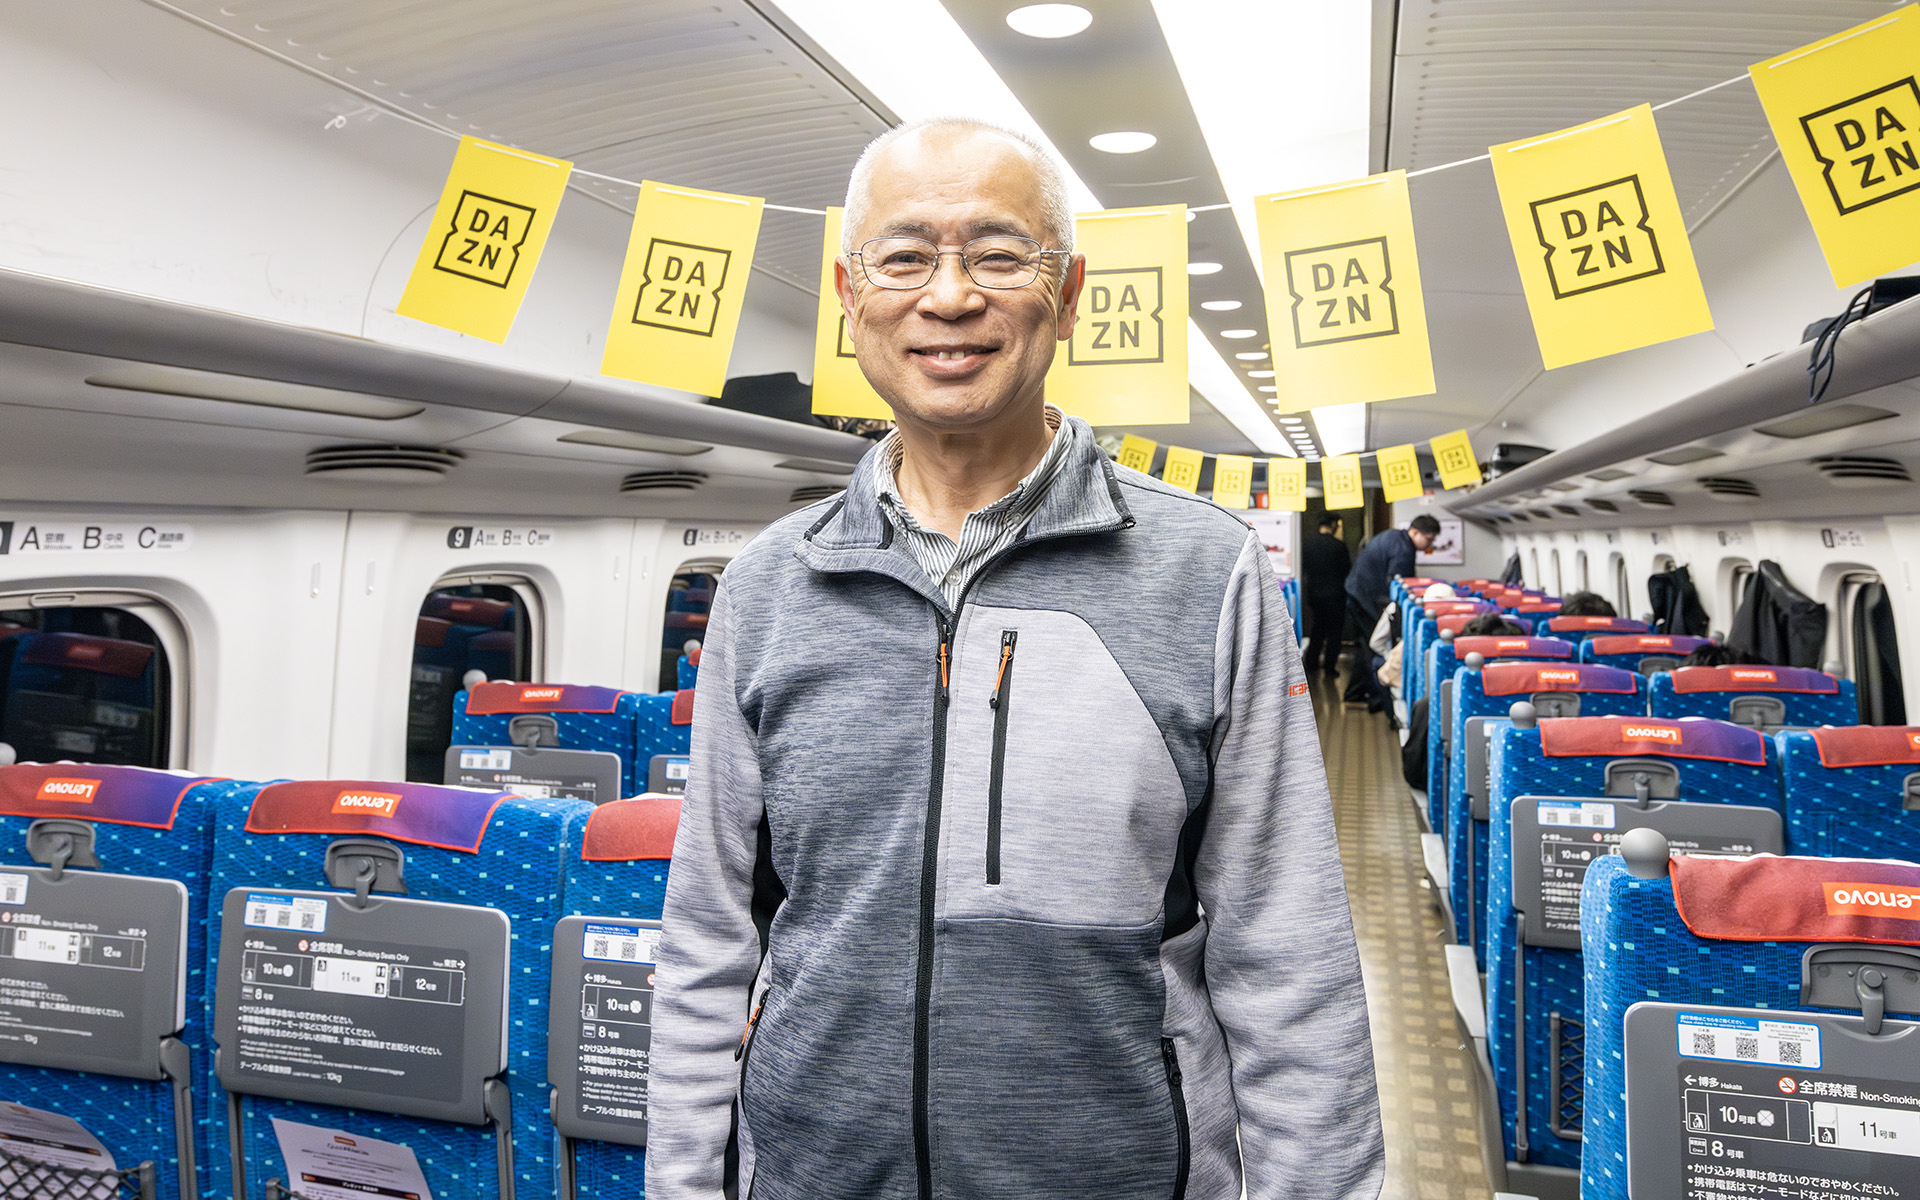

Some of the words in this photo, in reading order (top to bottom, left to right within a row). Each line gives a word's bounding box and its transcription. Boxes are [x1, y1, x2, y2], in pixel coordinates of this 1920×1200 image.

[1834, 106, 1907, 152] DA
[1850, 140, 1920, 189] ZN
[469, 208, 510, 240] DA
[1560, 201, 1625, 240] DA
[457, 238, 502, 270] ZN
[1570, 235, 1633, 277] ZN
[663, 256, 706, 287] DA
[1312, 258, 1369, 292] DA
[655, 288, 701, 319] ZN
[1091, 285, 1141, 314] DA
[1316, 293, 1371, 328] ZN
[1091, 320, 1140, 349] ZN
[20, 526, 40, 550] A
[83, 526, 102, 549] B
[138, 526, 156, 549] C
[454, 529, 465, 547] 9
[474, 529, 484, 546] A
[502, 529, 512, 546] B
[527, 529, 538, 546] C
[1626, 728, 1677, 741] Lenovo
[44, 782, 94, 798] Lenovo
[340, 795, 394, 813] Lenovo
[255, 988, 263, 1000] 8
[598, 1026, 606, 1038] 8
[1698, 1076, 1719, 1087] 博多
[1720, 1082, 1743, 1091] Hakata
[1799, 1080, 1857, 1099] 全席禁煙
[1711, 1140, 1724, 1157] 8
[1726, 1149, 1745, 1159] 号車
[1694, 1163, 1900, 1197] かけ込み乗車は危ないのでおやめください。
